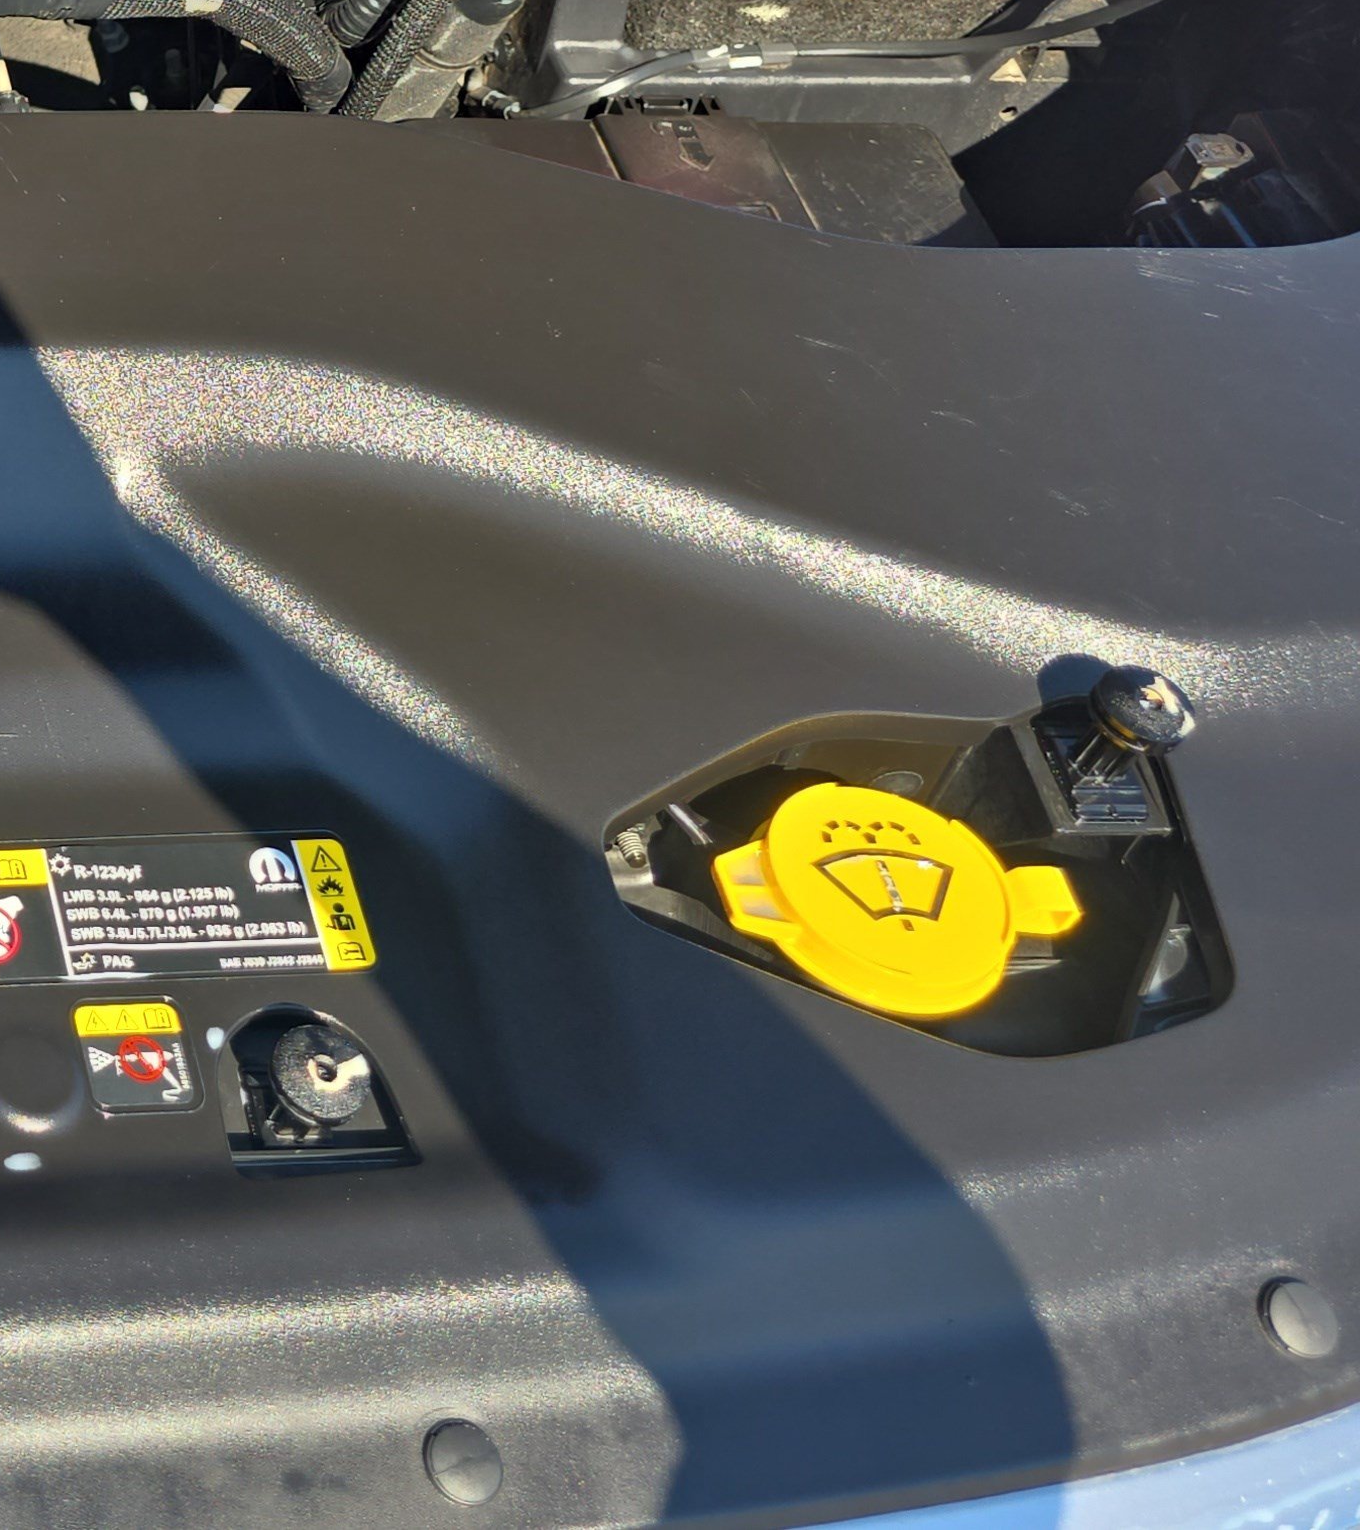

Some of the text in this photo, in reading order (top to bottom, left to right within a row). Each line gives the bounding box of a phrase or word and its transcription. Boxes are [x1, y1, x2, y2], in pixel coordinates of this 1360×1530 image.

[73, 864, 143, 883] R-1234yf
[62, 890, 96, 904] LWB
[173, 887, 214, 902] (2.125
[215, 885, 236, 902] lb)
[66, 908, 100, 921] SWB
[101, 907, 131, 920] 6.4L
[178, 905, 217, 920] (1.937
[219, 904, 240, 920] lb)
[71, 927, 105, 941] SWB
[286, 921, 308, 936] lb)
[102, 955, 134, 969] PAG
